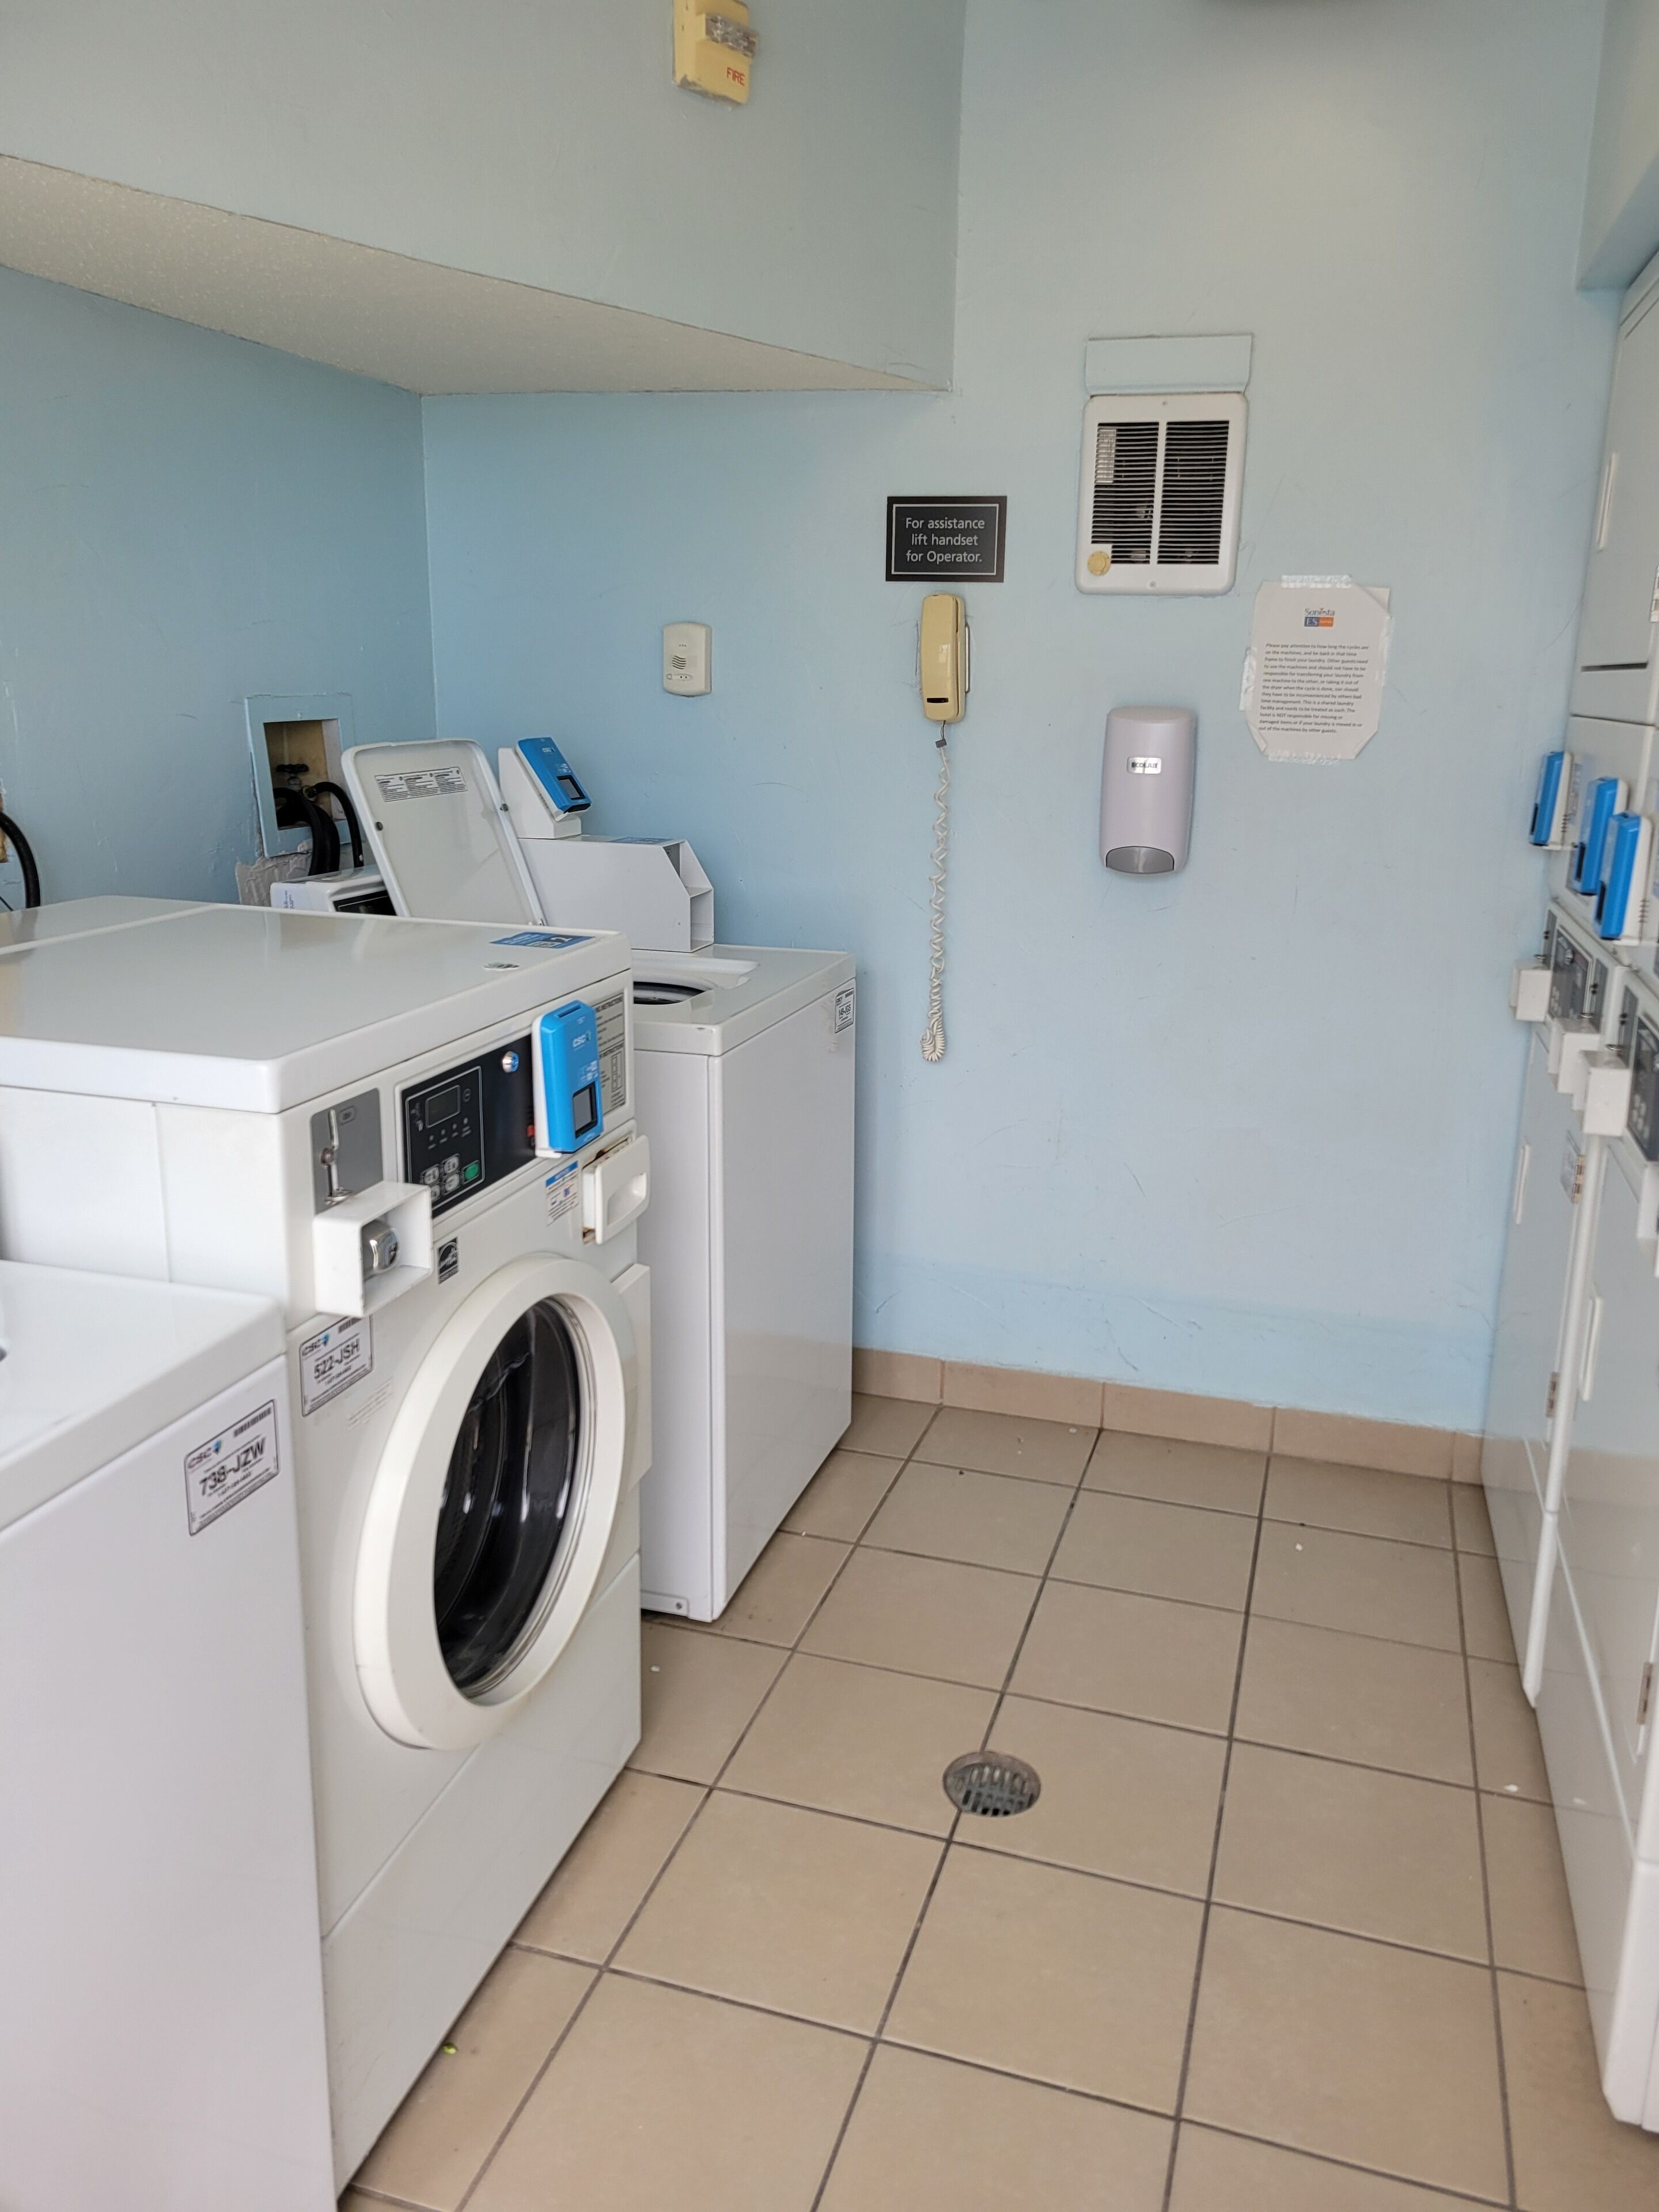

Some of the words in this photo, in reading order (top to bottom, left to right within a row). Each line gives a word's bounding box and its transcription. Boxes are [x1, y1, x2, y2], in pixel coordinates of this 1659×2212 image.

[726, 66, 745, 86] FIRE
[906, 517, 924, 529] For
[927, 517, 985, 529] assistance
[911, 533, 927, 546] lift
[931, 533, 979, 546] handset
[906, 550, 924, 562] for
[927, 551, 982, 565] Operator.
[188, 1447, 212, 1469] CSC
[199, 1437, 267, 1496] 738-JZW
